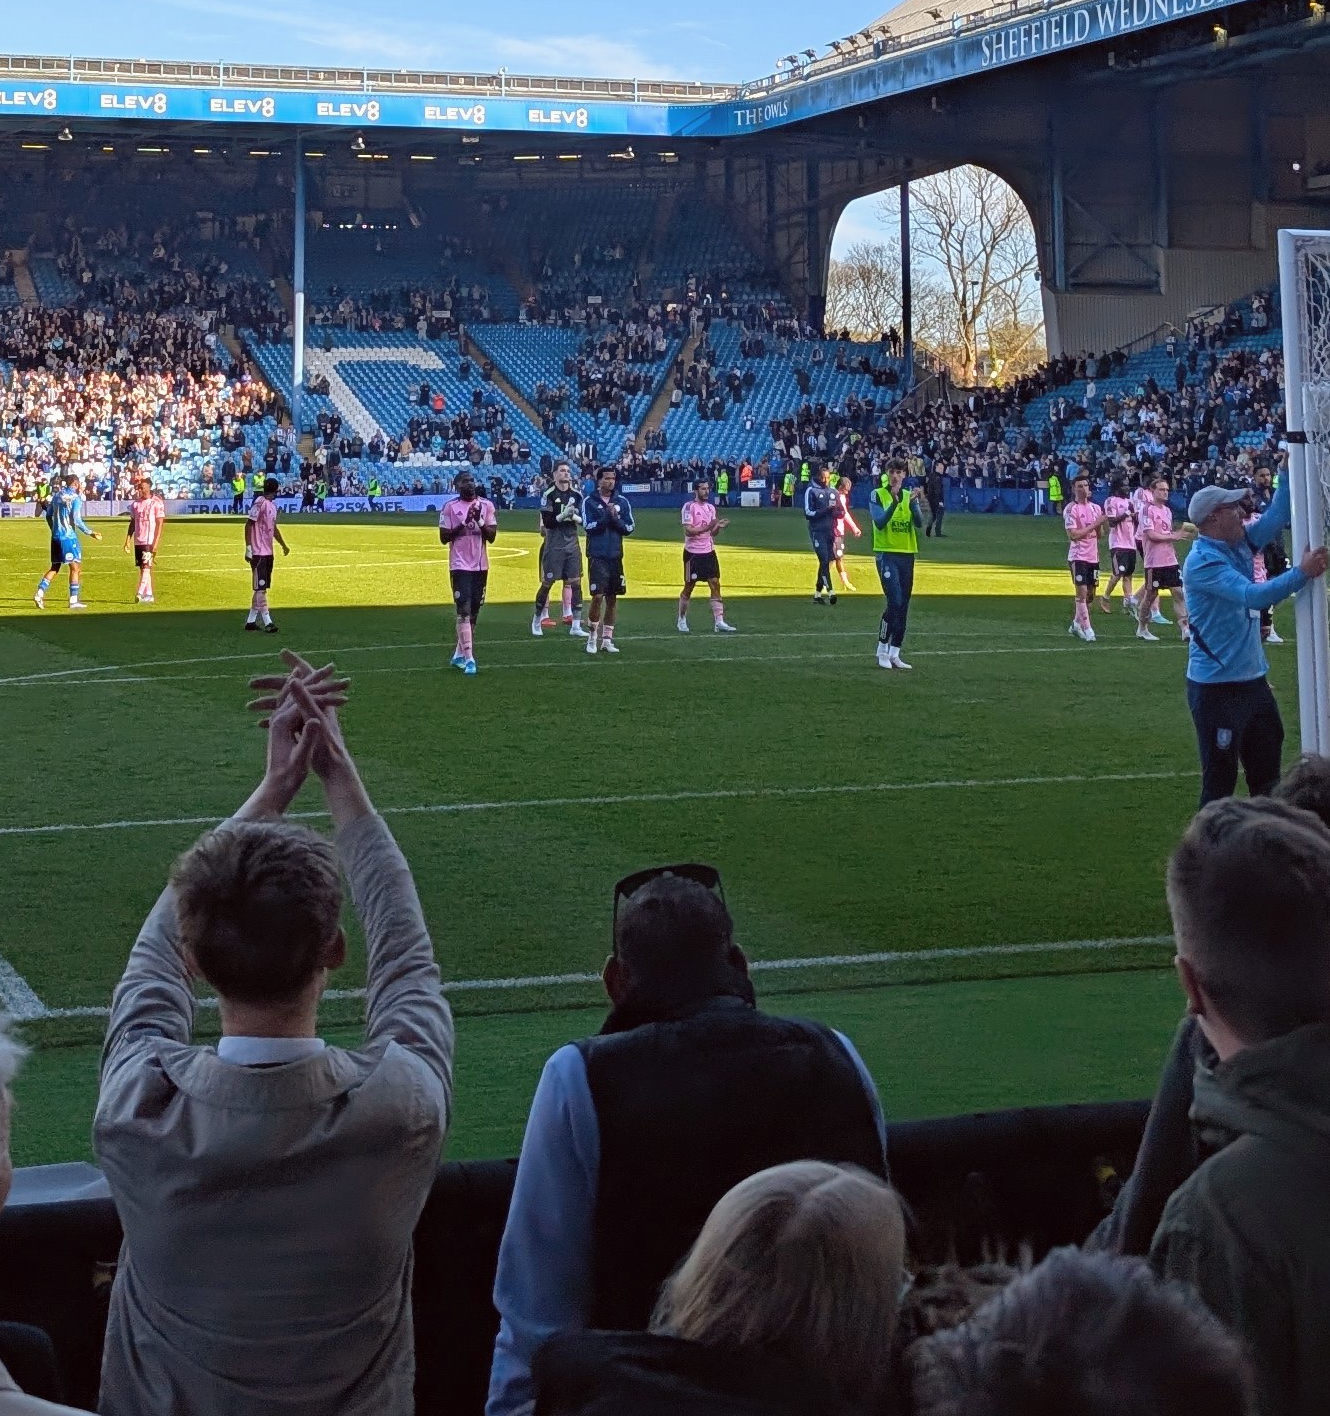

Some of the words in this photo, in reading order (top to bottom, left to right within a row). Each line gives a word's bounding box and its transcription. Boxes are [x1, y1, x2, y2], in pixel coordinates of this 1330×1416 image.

[981, 8, 1090, 67] SHEFFIELD
[100, 92, 167, 114] ELEV8
[210, 96, 275, 118] ELEV8
[317, 100, 380, 121] ELEV8
[734, 107, 763, 126] THE
[764, 99, 788, 121] OWLS
[424, 104, 485, 125] ELEV8
[528, 107, 588, 128] ELEV8
[336, 502, 368, 512] 25%
